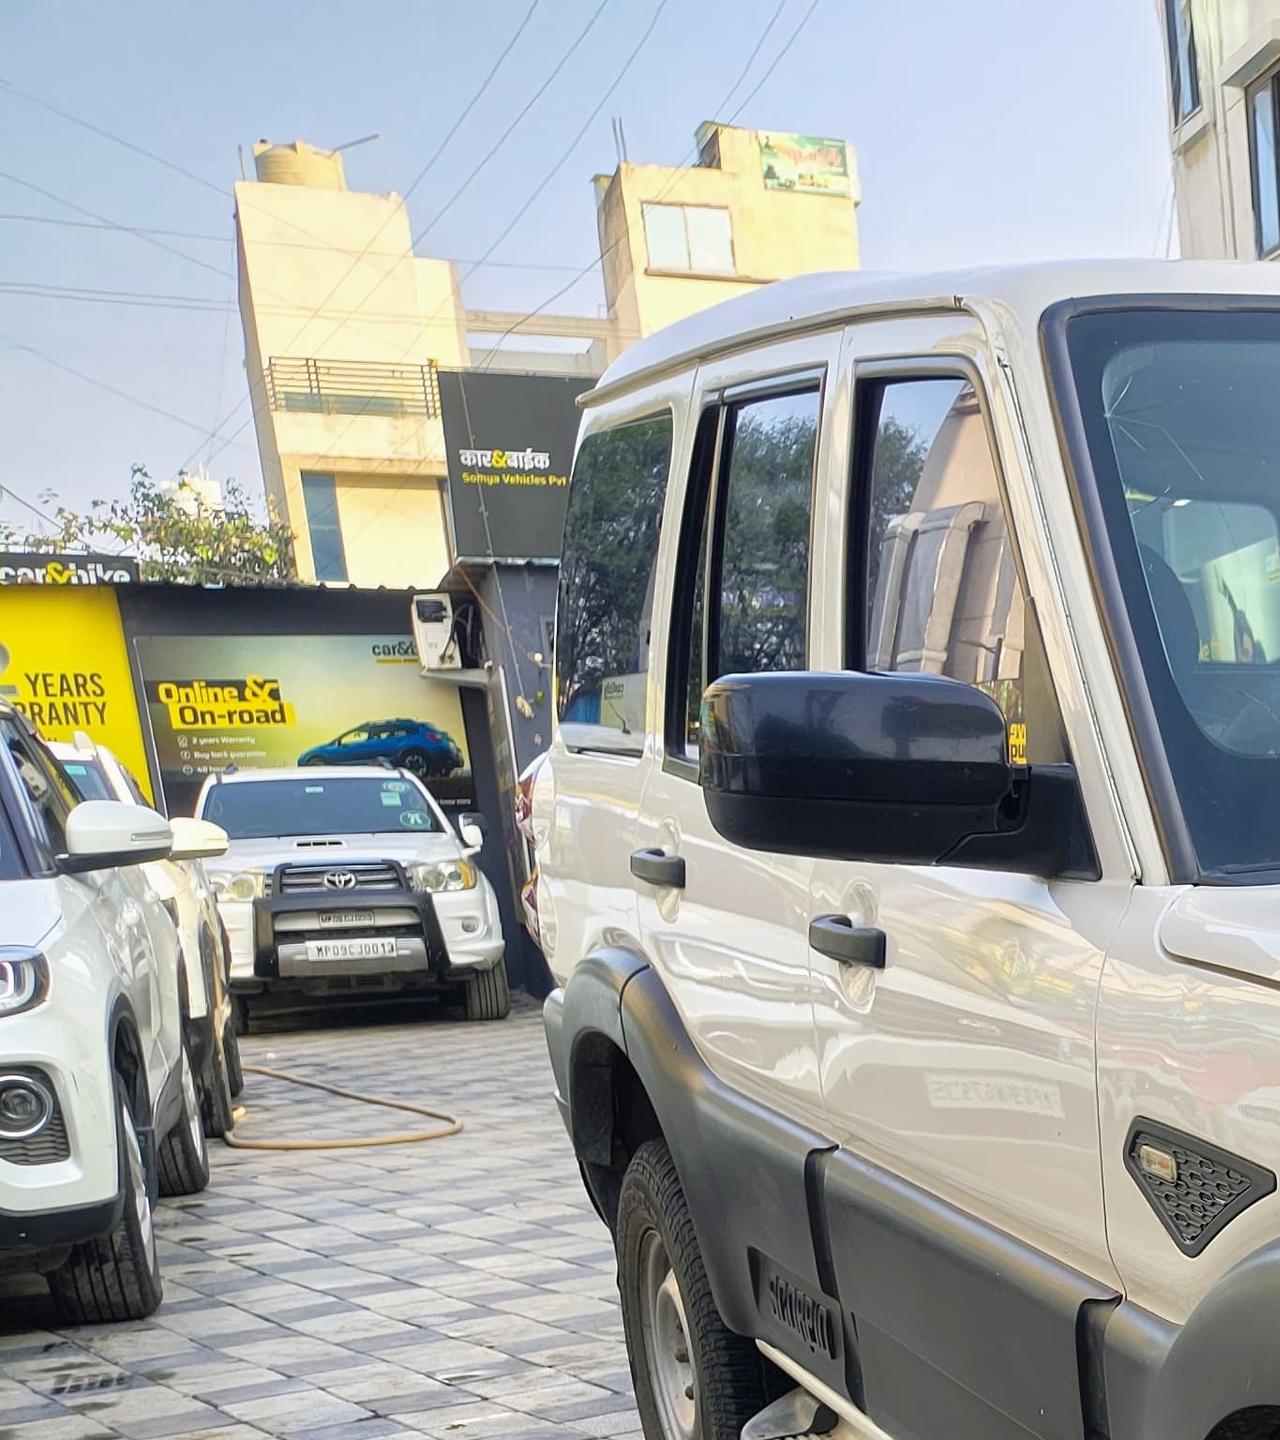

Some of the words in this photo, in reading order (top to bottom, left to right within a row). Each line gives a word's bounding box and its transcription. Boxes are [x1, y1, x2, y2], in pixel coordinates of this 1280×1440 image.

[502, 473, 546, 486] Vehicles
[548, 475, 567, 487] Pvt
[24, 672, 106, 698] YEARS
[158, 680, 240, 704] Online
[244, 674, 281, 703] &
[178, 704, 288, 726] On-road
